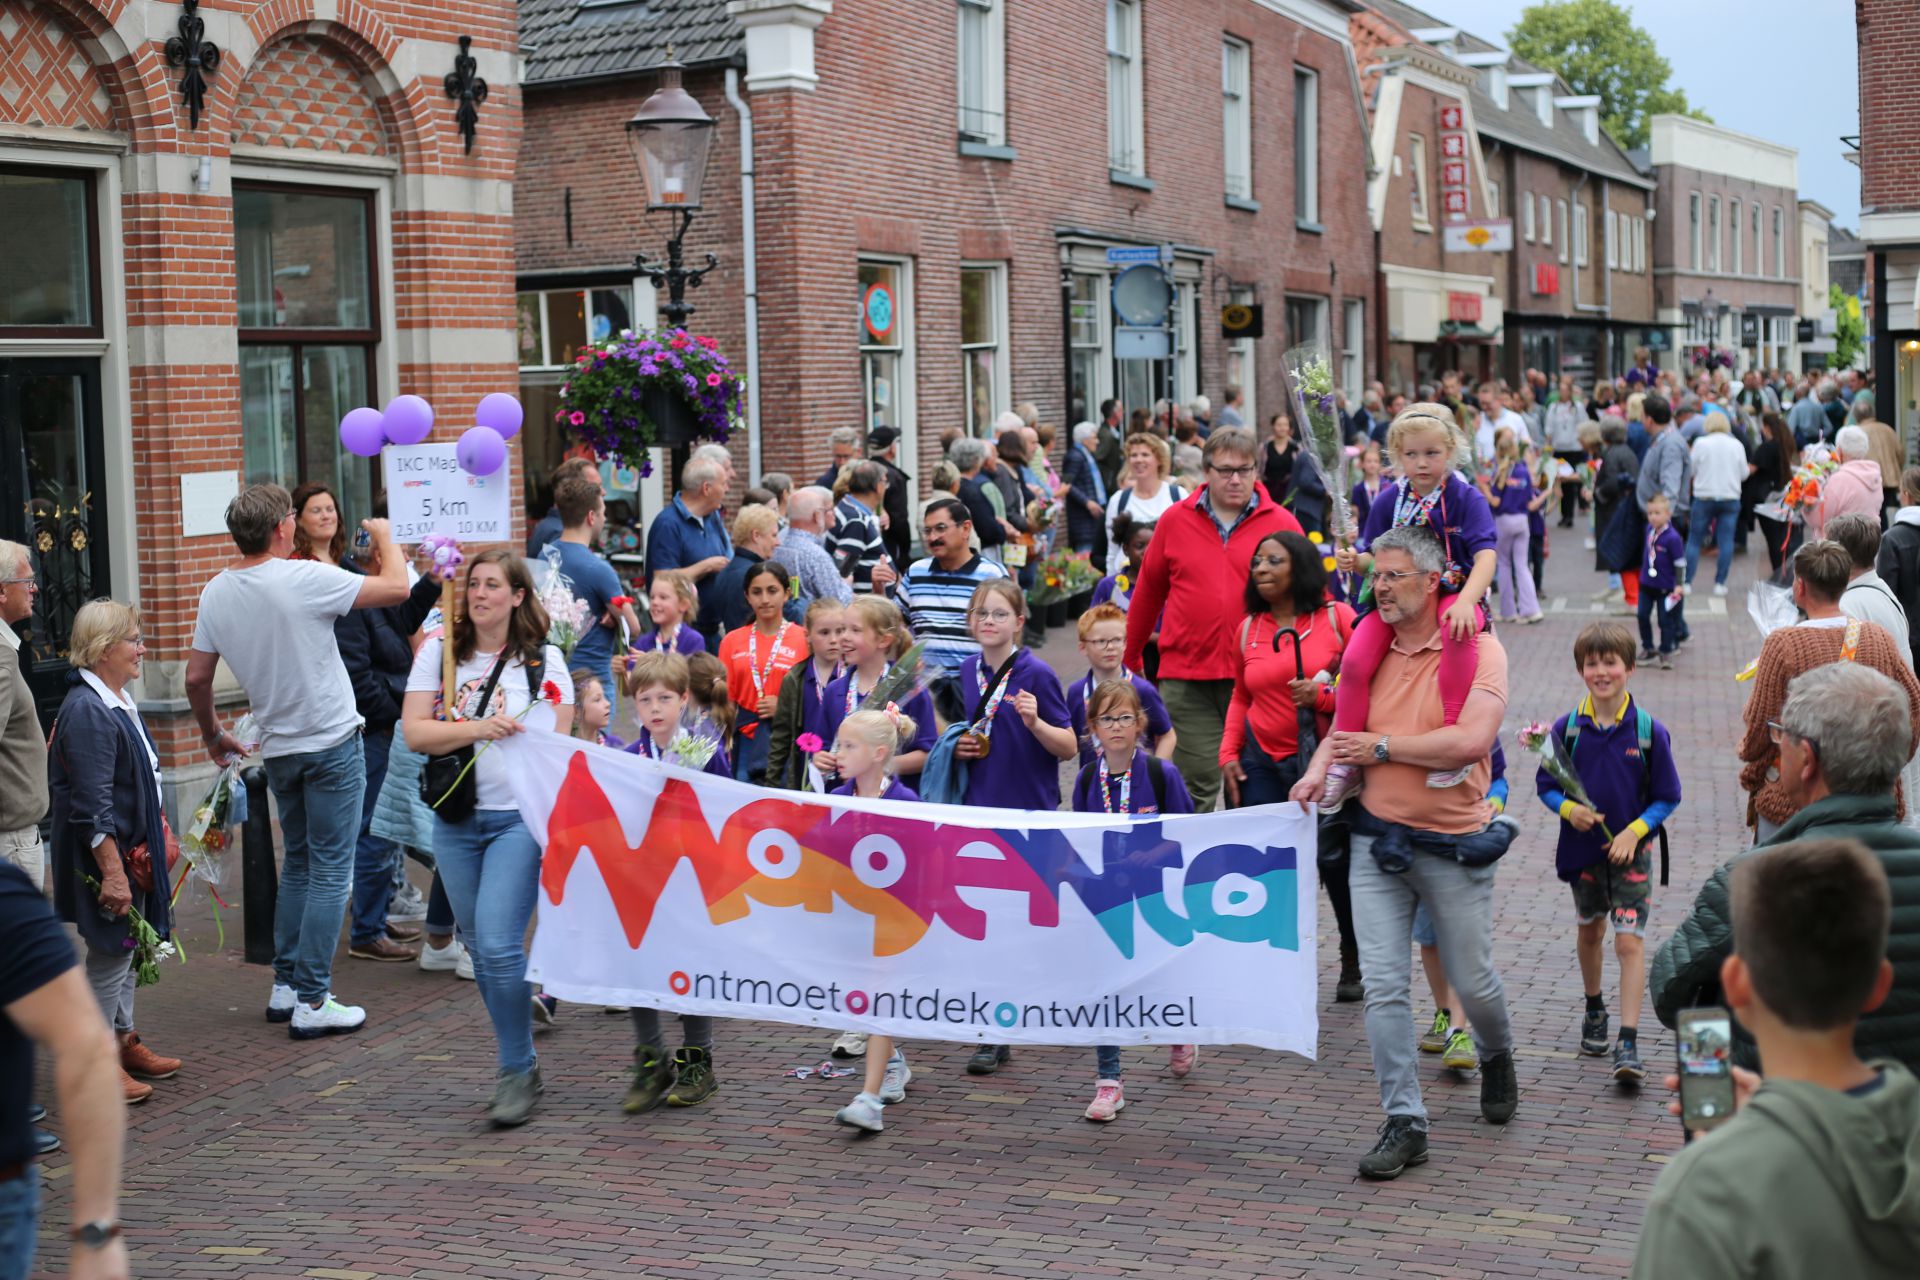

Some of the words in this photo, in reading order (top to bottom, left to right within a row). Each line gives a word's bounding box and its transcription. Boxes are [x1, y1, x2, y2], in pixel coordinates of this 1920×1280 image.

[396, 456, 424, 472] IKC
[428, 456, 458, 474] Mag
[422, 498, 432, 517] 5
[439, 497, 469, 516] km
[416, 521, 435, 534] KM
[457, 521, 473, 534] 10
[476, 520, 498, 533] KM
